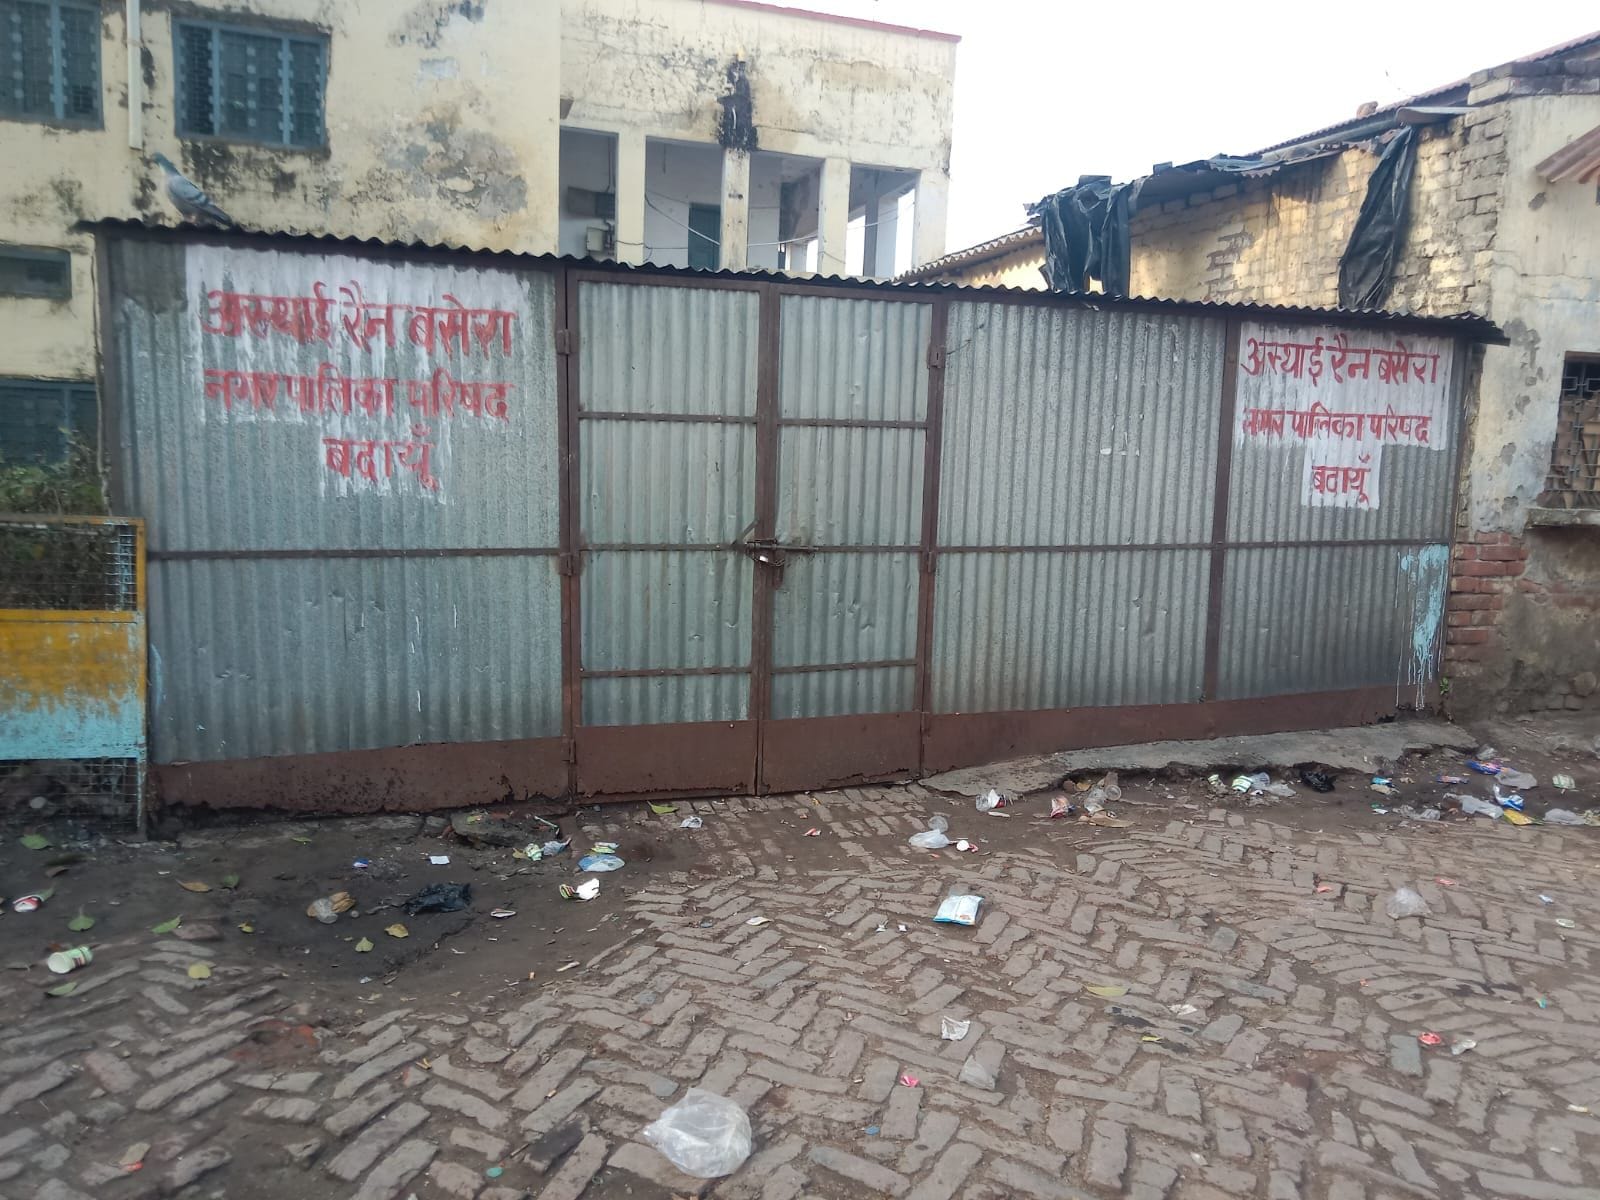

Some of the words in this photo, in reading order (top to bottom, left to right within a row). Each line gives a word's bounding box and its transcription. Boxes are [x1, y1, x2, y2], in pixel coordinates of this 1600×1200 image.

[340, 279, 406, 352] रैन
[409, 294, 518, 359] बसेरा
[1325, 333, 1372, 384] रैन
[1373, 340, 1440, 385] बसेरा
[203, 368, 278, 411] नगर
[284, 362, 398, 417] पालिका
[1287, 401, 1365, 441] पालिका
[322, 424, 438, 491] बदायूँ
